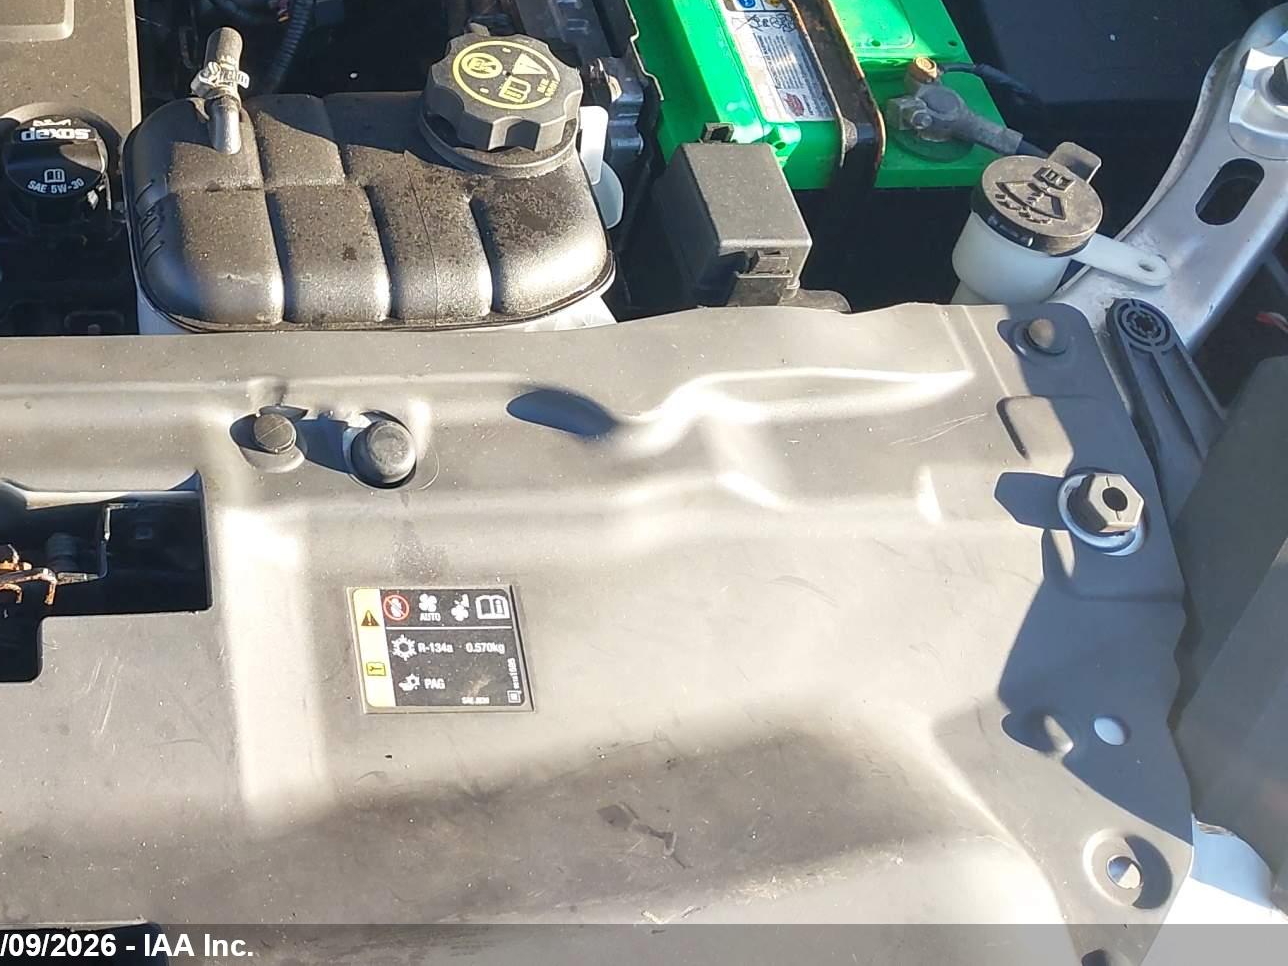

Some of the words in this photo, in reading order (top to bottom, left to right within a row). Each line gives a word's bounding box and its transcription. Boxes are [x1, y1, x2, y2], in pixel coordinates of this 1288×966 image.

[21, 127, 91, 141] dexos
[27, 180, 48, 194] SAE
[50, 178, 85, 194] 5W-30
[419, 612, 441, 622] AUTO
[417, 642, 454, 653] R-134a
[465, 642, 506, 654] 0.570kg
[424, 678, 446, 690] PAG
